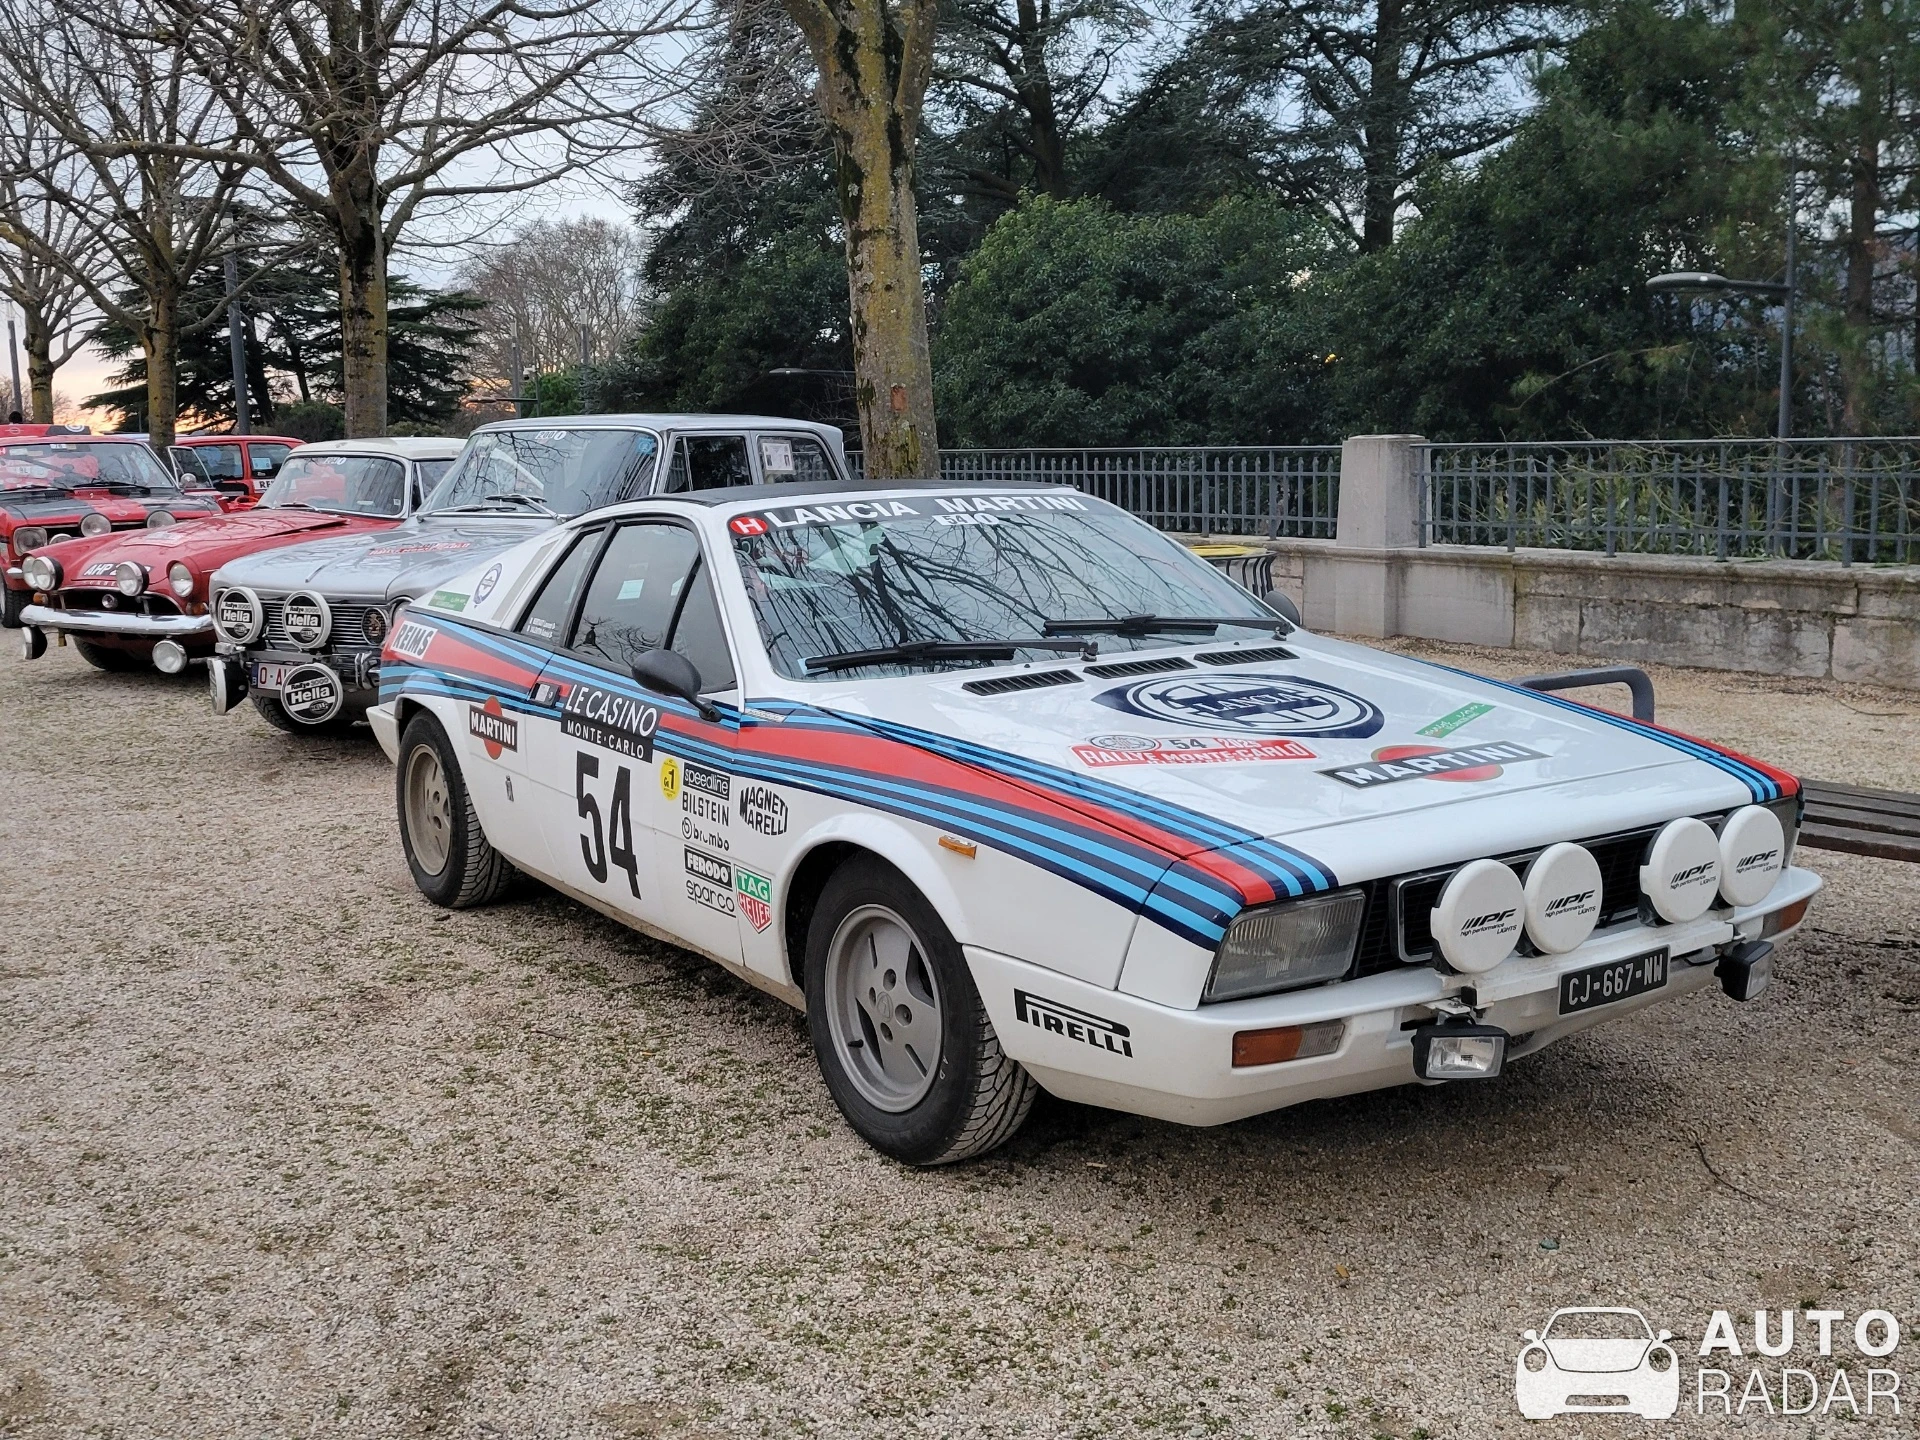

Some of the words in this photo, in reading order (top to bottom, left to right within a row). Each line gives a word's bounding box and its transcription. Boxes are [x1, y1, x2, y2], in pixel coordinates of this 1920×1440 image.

[736, 518, 763, 534] H
[764, 501, 920, 528] LANCIA
[934, 496, 1089, 513] MARTINI
[944, 515, 967, 525] 54
[84, 563, 114, 576] AHP
[223, 609, 250, 622] Hella
[288, 613, 318, 626] Hella
[392, 624, 434, 656] REIMS
[291, 686, 330, 704] Hella
[1193, 692, 1299, 713] LANCIA
[471, 711, 515, 746] MARTINI
[1082, 751, 1157, 764] RALLYE
[1165, 742, 1310, 762] MONTE-CARLO
[1170, 738, 1207, 749] 54
[1335, 745, 1533, 785] MARTINI
[684, 768, 729, 795] speedline
[682, 791, 729, 827] BILSTEIN
[740, 786, 788, 820] MAGNETI
[577, 750, 642, 900] 54
[740, 805, 788, 836] MARELLI
[687, 852, 728, 883] FERODO
[686, 879, 735, 913] sparco
[738, 871, 768, 901] TAG
[739, 893, 771, 927] HEUER
[1556, 904, 1584, 916] performance
[1578, 906, 1596, 915] LIGHTS
[1472, 923, 1505, 936] performance
[1497, 925, 1518, 934] LIGHTS
[1568, 953, 1663, 1006] CJ-667-NW
[1014, 988, 1133, 1058] PIRELLI
